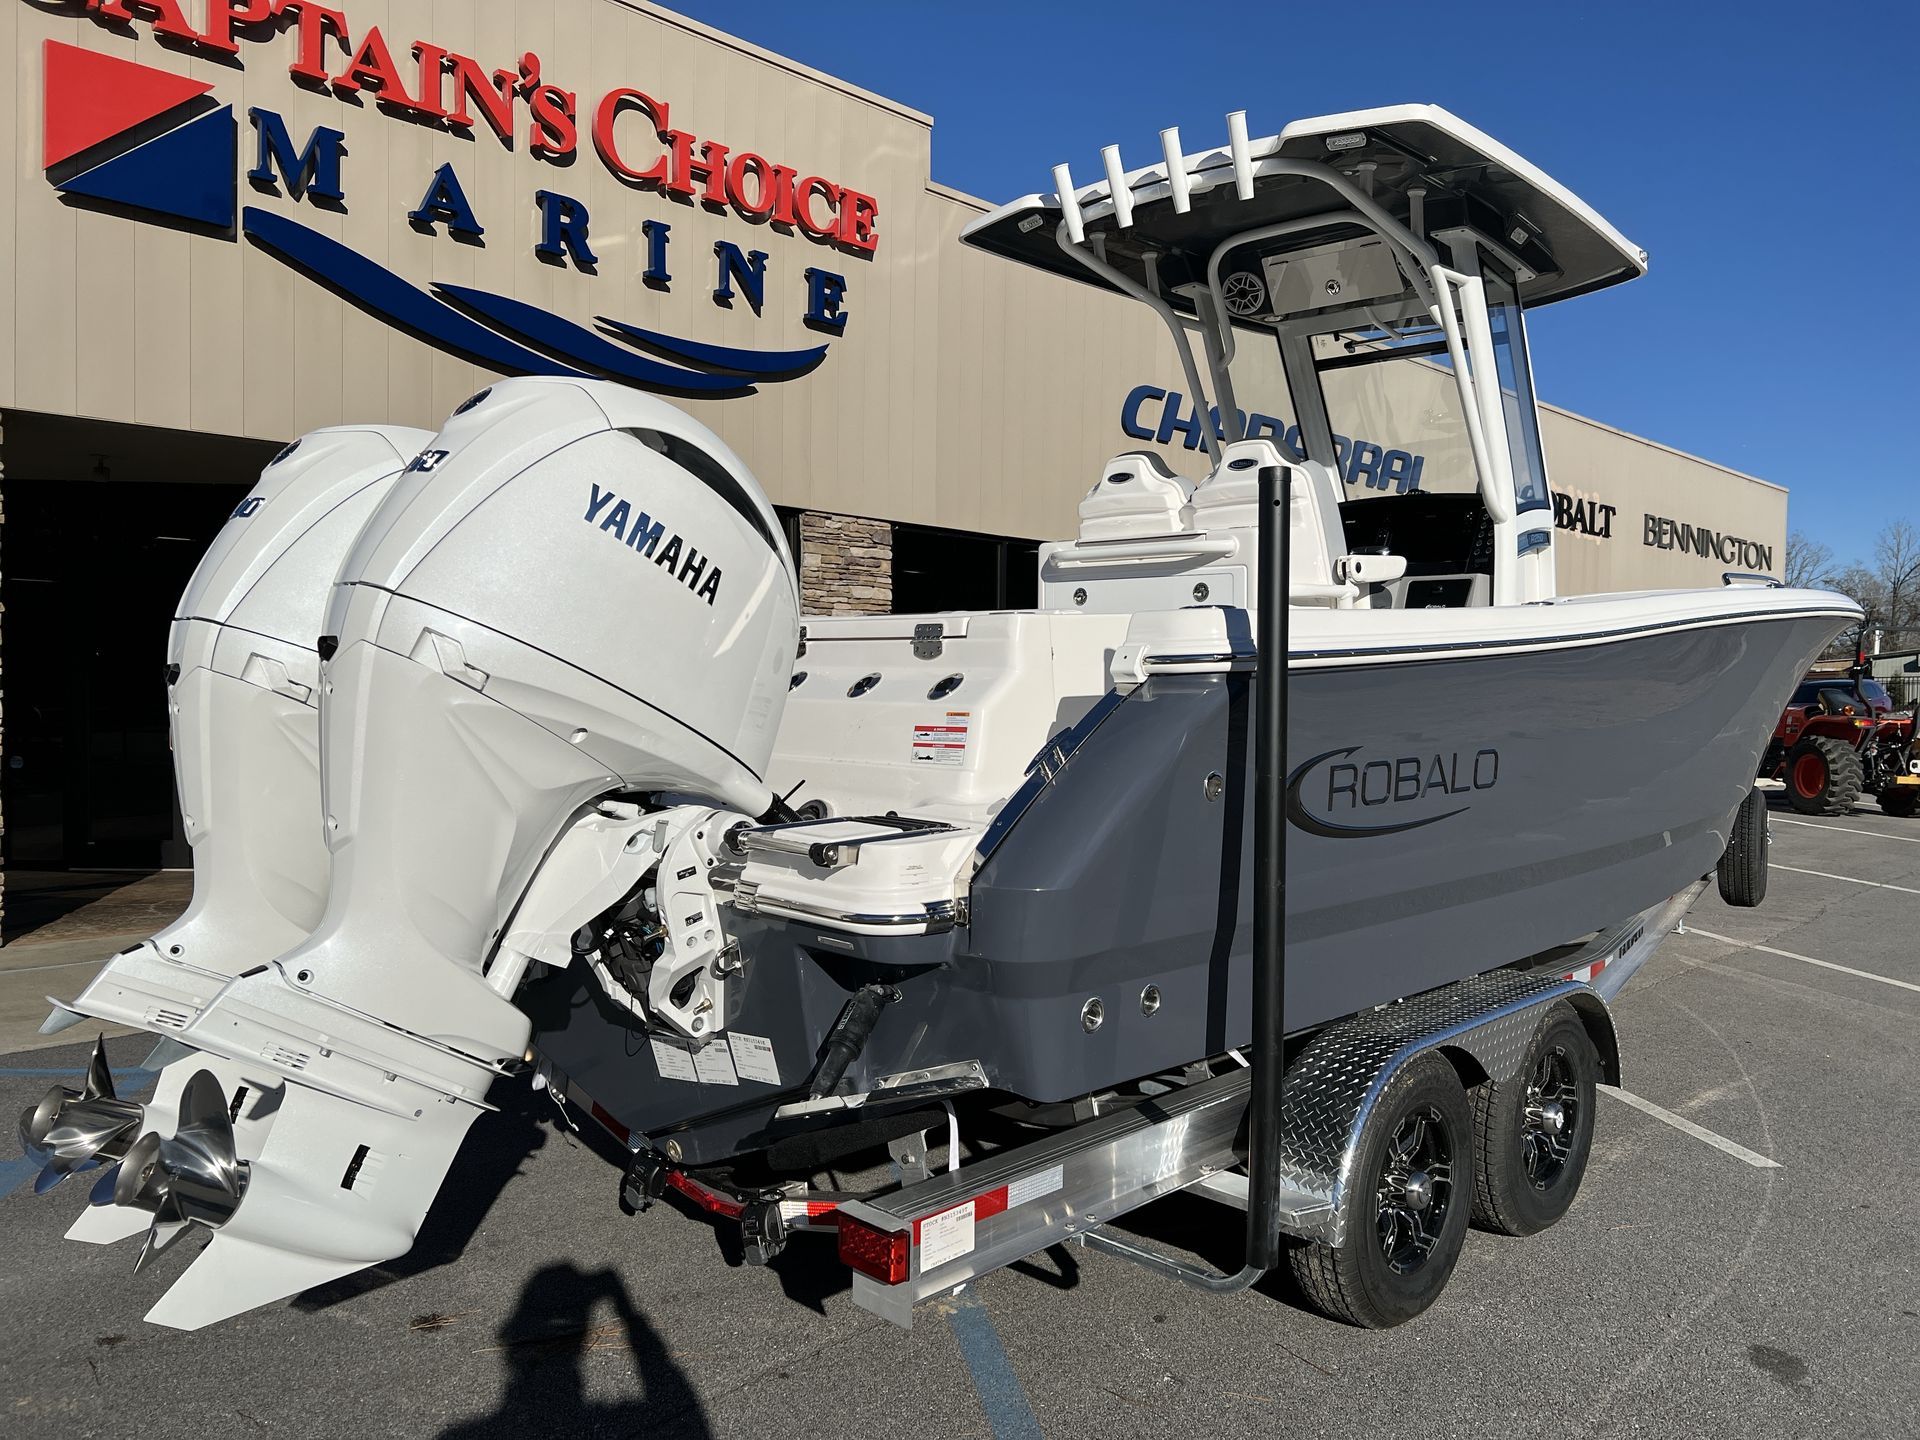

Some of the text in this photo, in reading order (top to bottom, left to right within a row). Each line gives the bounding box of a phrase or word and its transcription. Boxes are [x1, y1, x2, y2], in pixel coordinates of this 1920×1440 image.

[85, 0, 879, 251] PTAIN'S CHOICE
[247, 107, 848, 328] MARINE
[584, 482, 722, 606] YAMAHA
[1643, 513, 1772, 571] BENNINGTON
[1328, 749, 1499, 812] ROBALO
